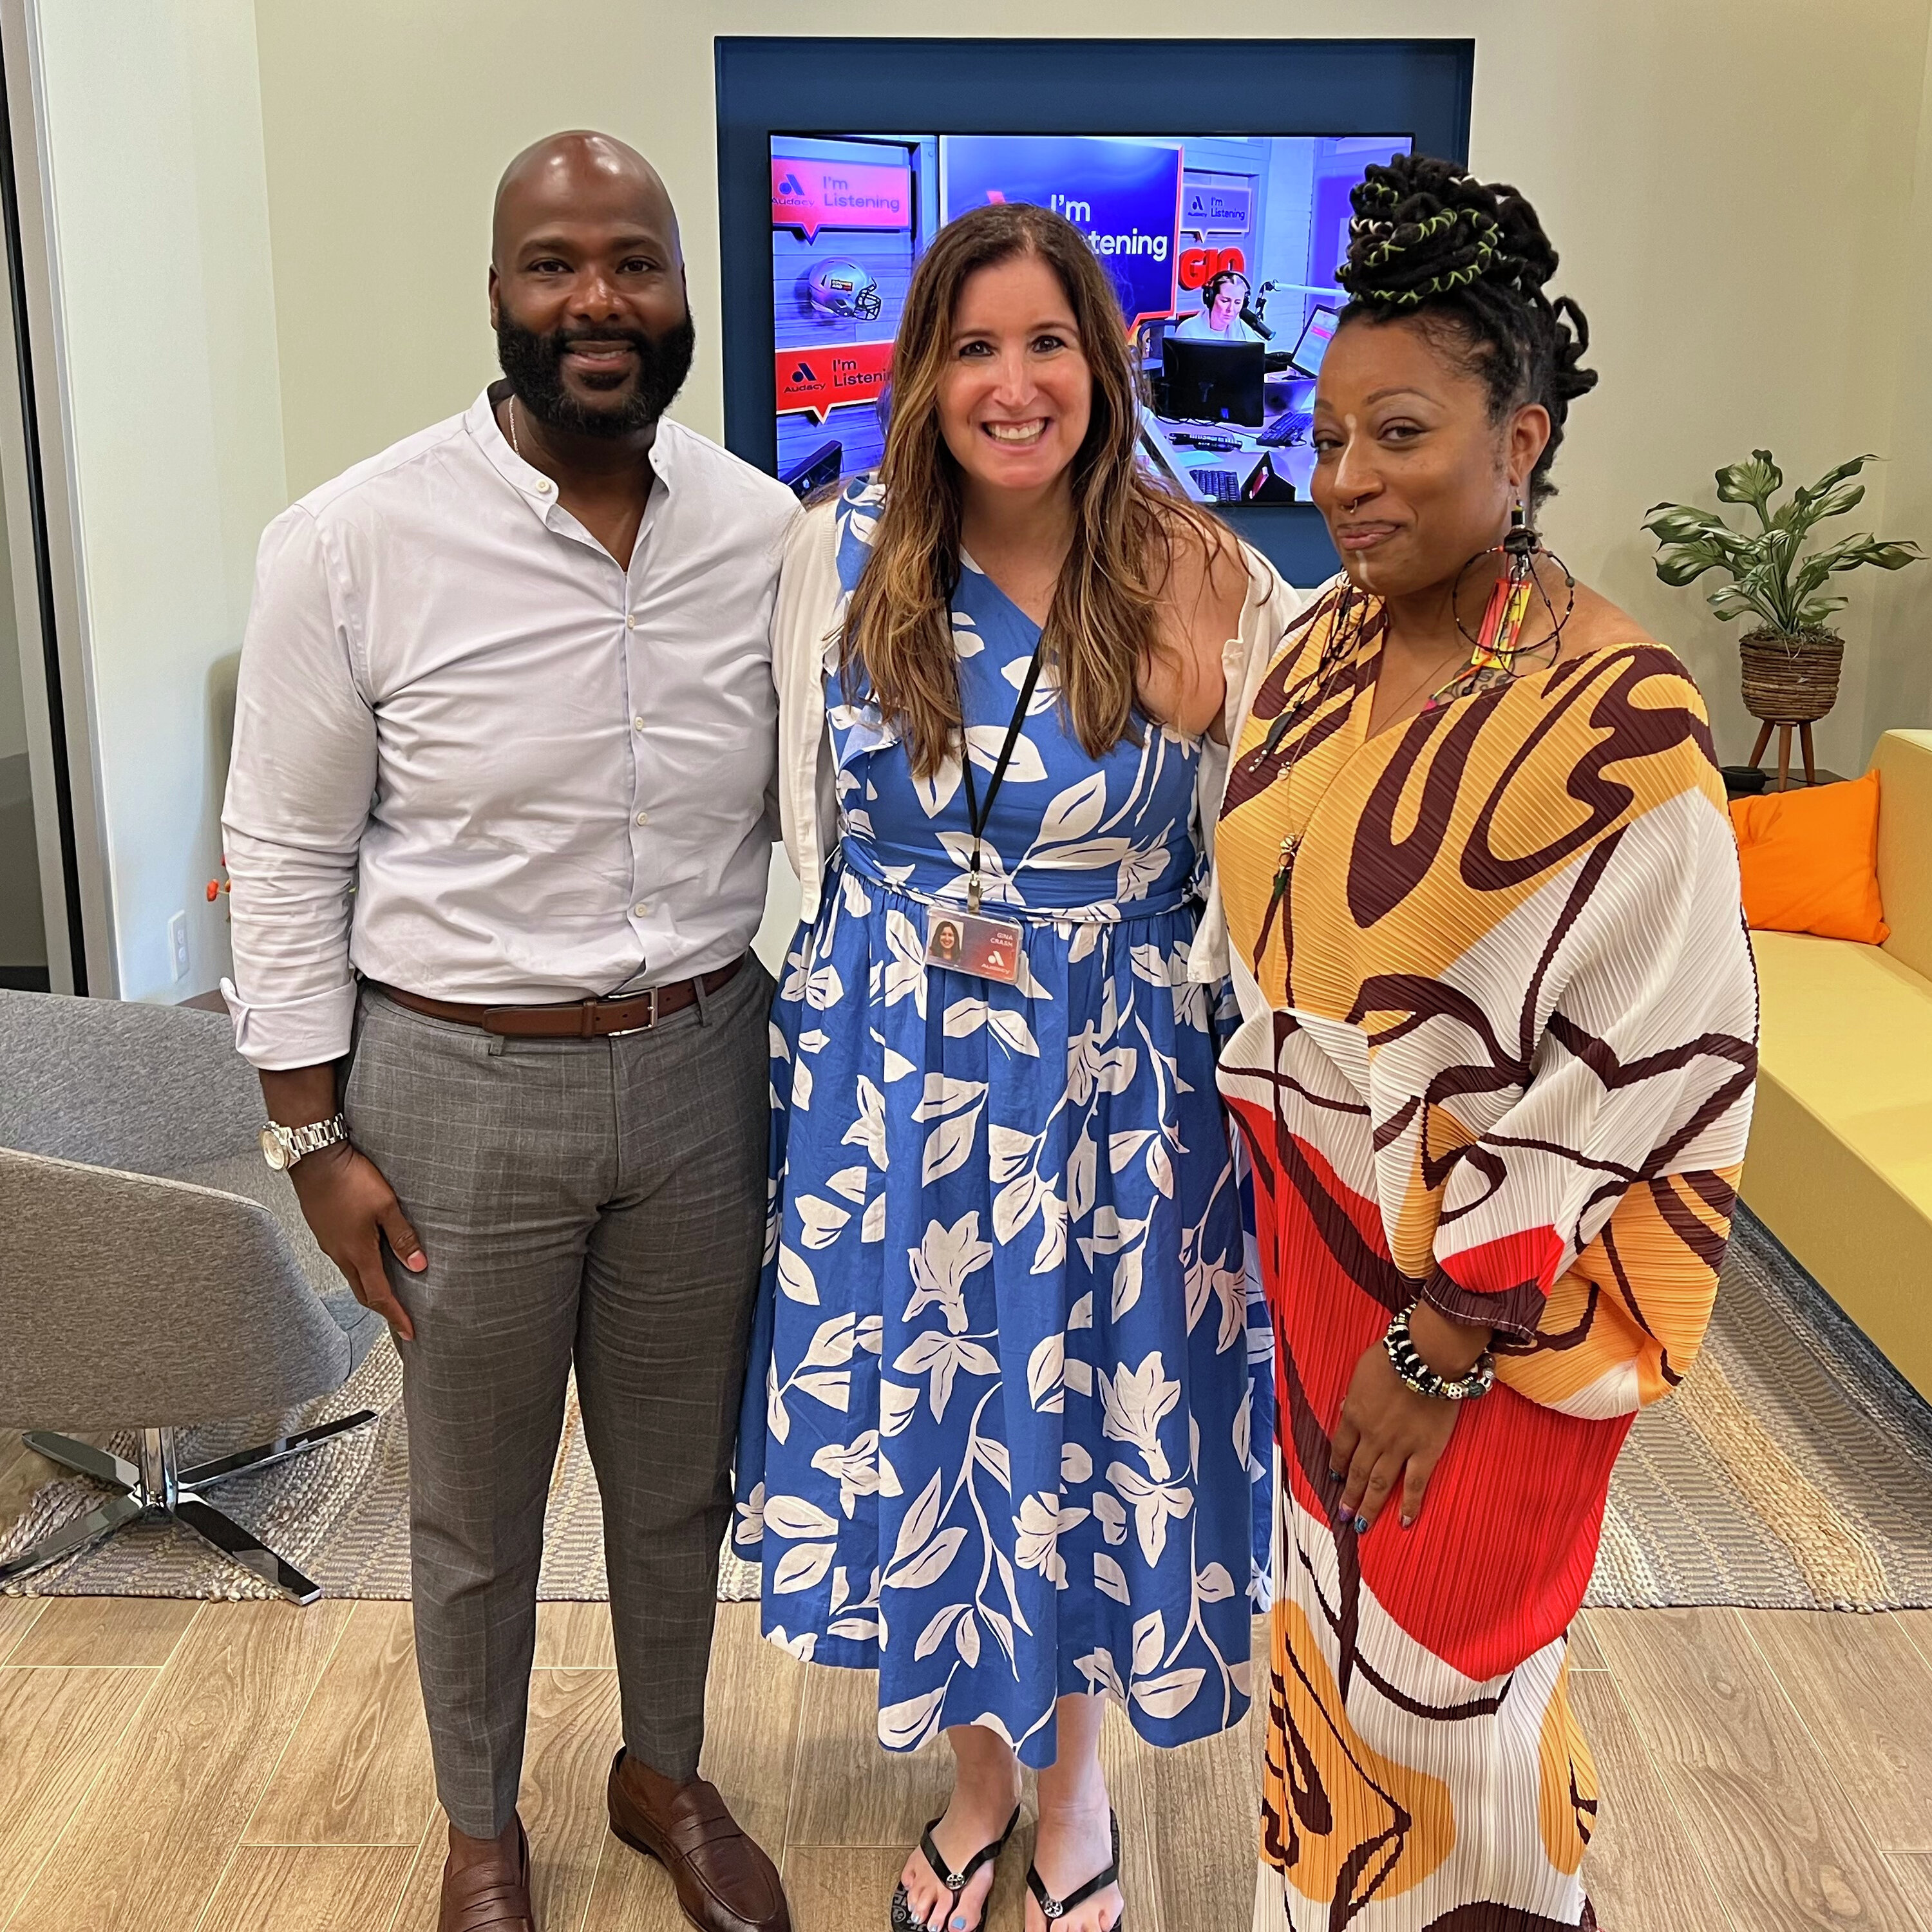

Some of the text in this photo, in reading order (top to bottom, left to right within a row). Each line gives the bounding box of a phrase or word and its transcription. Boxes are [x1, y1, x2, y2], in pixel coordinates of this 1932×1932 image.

[823, 176, 848, 191] I'm
[824, 193, 900, 213] Listening
[1051, 194, 1090, 222] I'm
[1211, 196, 1224, 207] I'm
[1211, 207, 1245, 221] Listening
[1088, 228, 1168, 262] tening
[833, 359, 857, 372] I'm
[784, 383, 826, 393] Audacy
